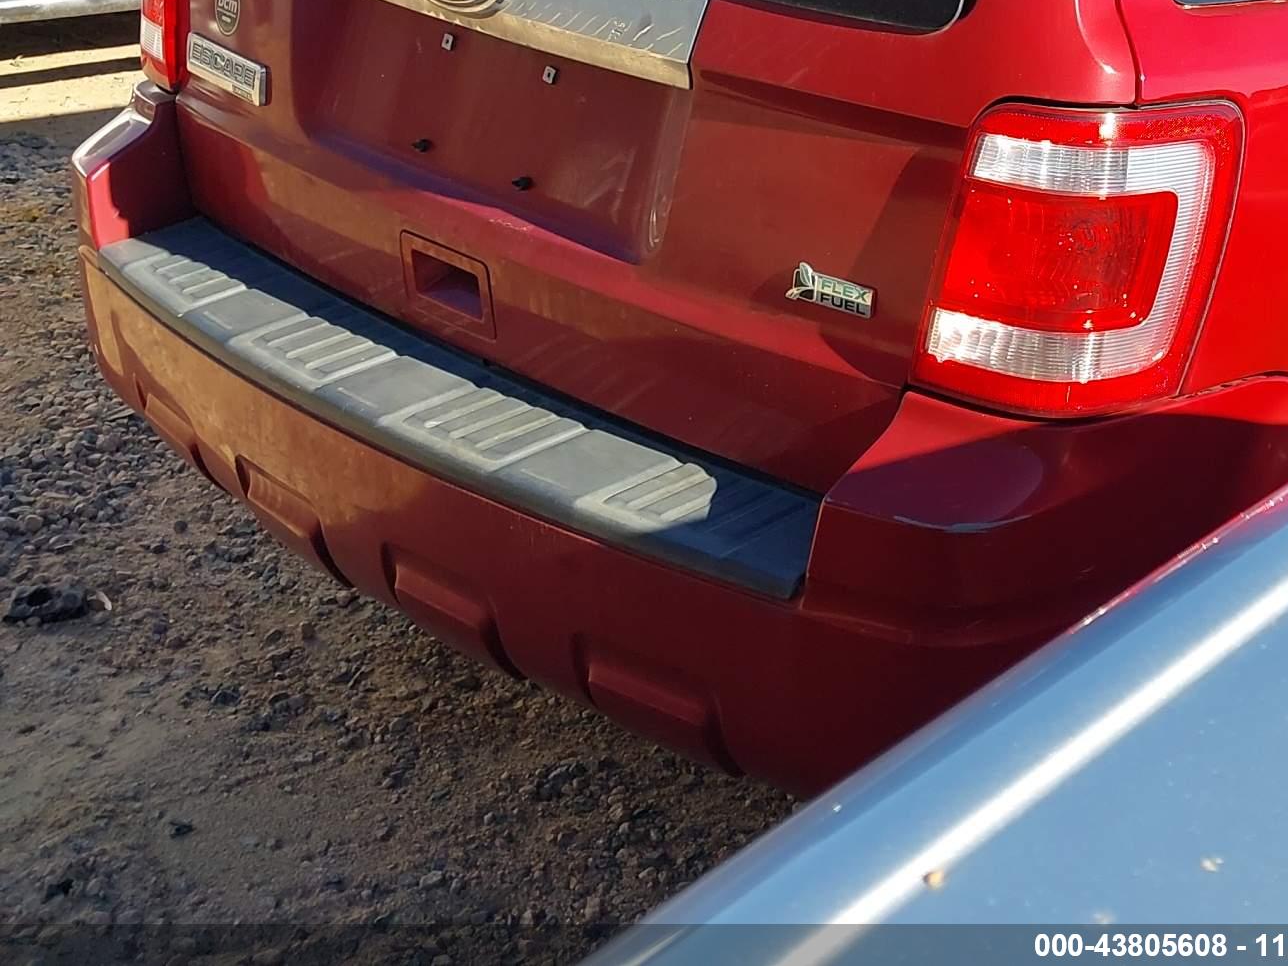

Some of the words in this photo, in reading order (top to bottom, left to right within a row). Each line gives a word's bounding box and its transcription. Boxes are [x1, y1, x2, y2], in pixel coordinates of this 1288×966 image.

[192, 42, 256, 90] ESCAPE
[821, 277, 869, 302] FLEX
[820, 293, 866, 315] FUEL
